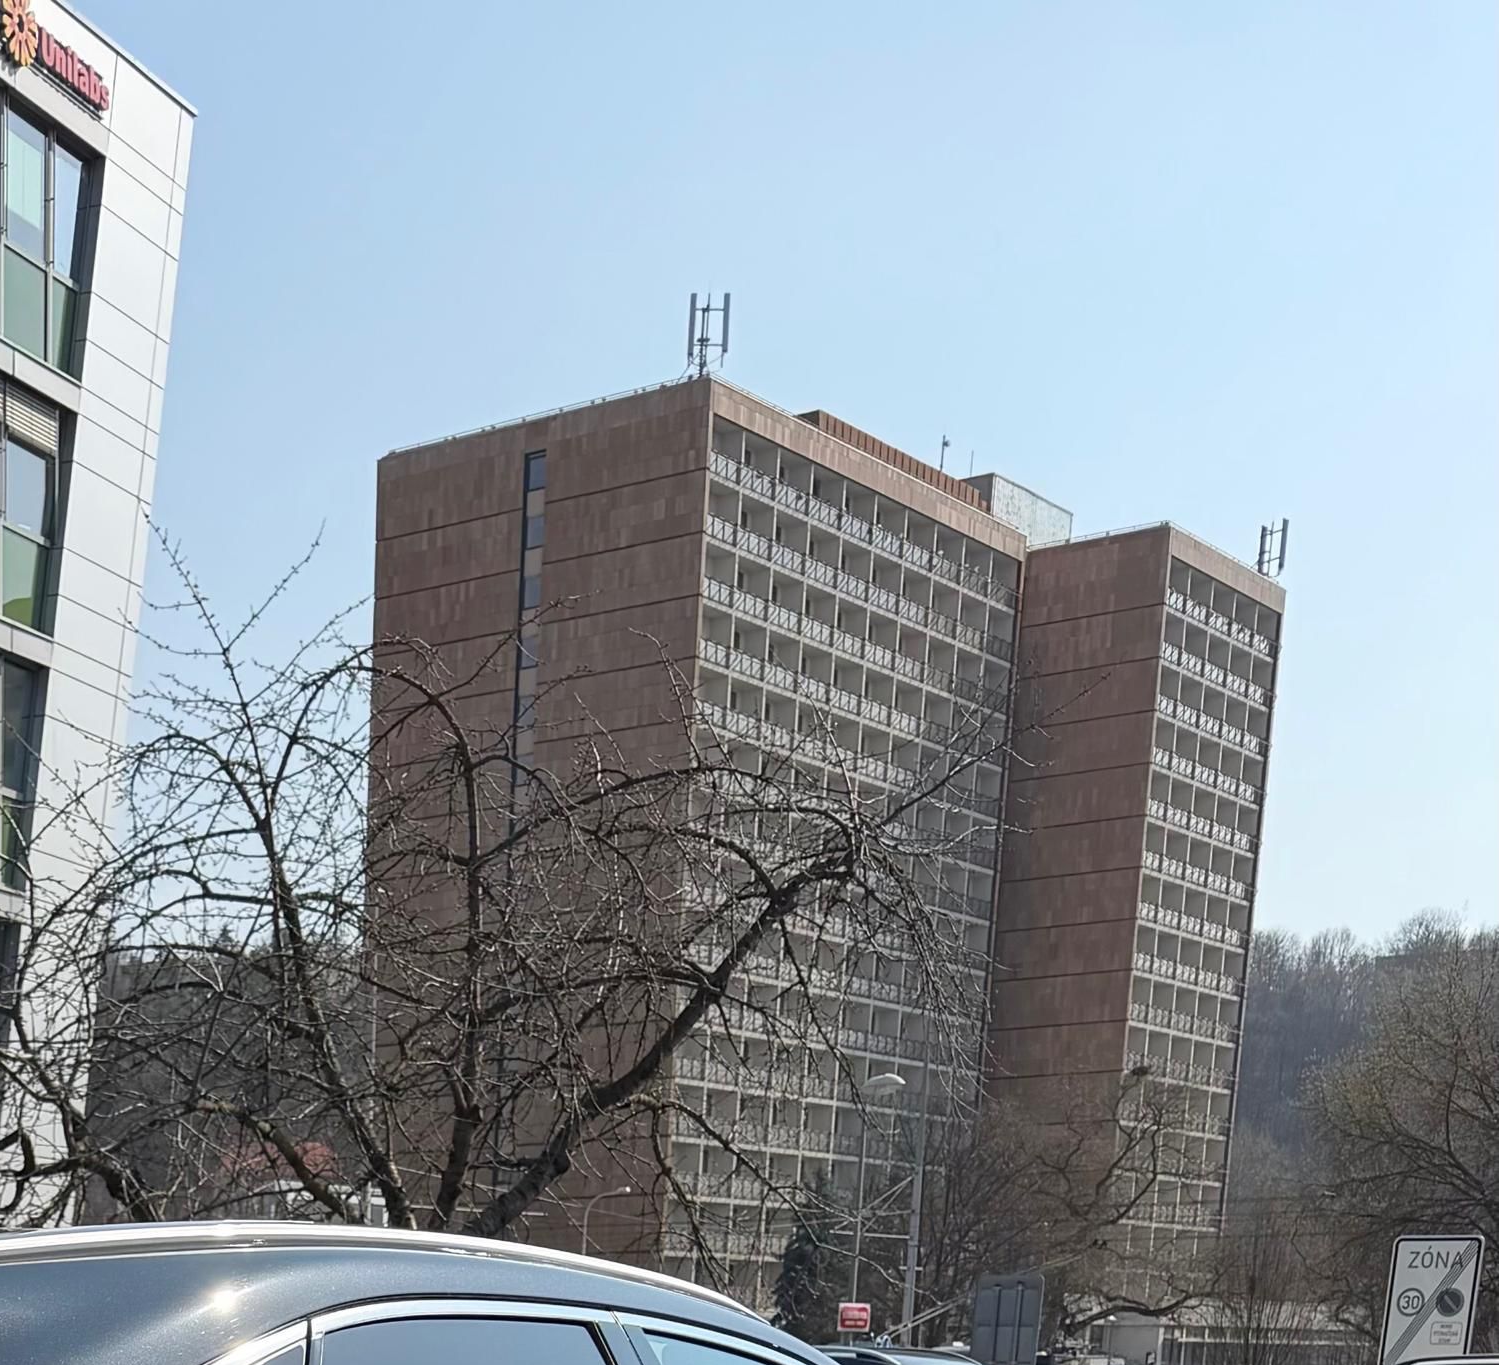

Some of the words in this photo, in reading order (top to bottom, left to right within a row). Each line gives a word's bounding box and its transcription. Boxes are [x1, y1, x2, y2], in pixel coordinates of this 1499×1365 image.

[38, 26, 110, 112] Unilabs
[1407, 1245, 1464, 1269] ZÓNA
[1402, 1295, 1421, 1310] 30
